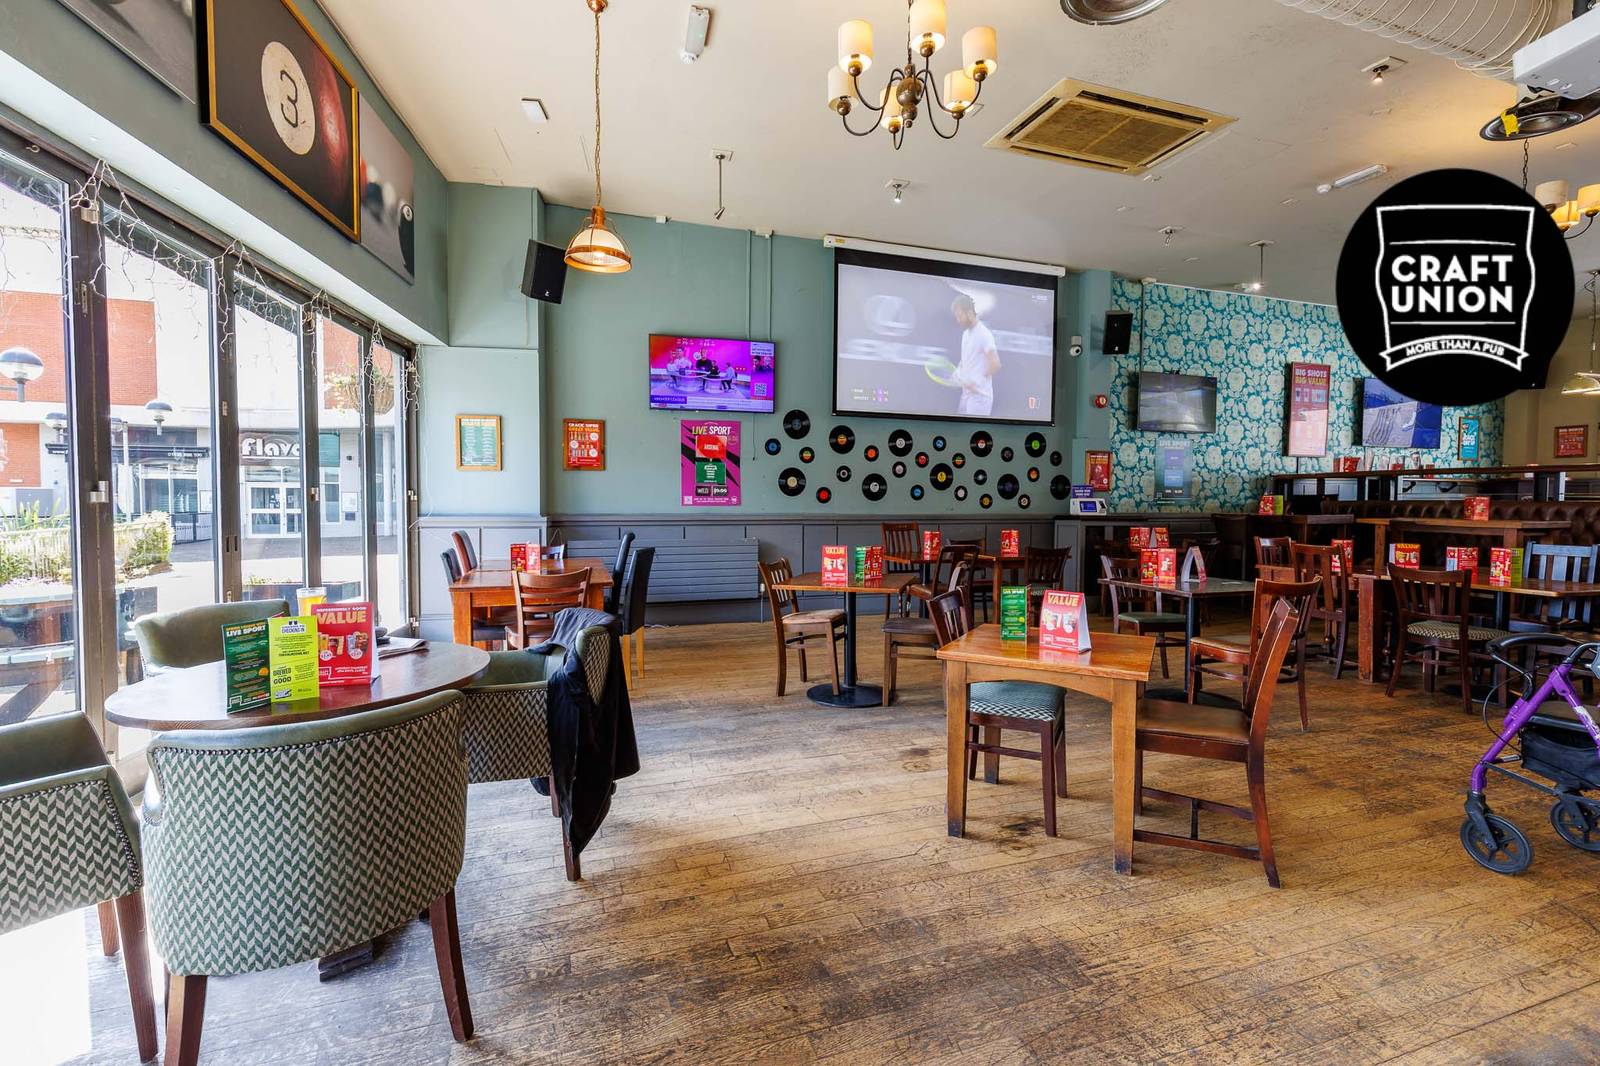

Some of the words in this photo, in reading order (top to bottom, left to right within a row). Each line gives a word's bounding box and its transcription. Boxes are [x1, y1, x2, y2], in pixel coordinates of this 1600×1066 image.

[280, 69, 299, 129] 3
[1295, 368, 1307, 376] BIG
[1307, 369, 1328, 378] SHOTS
[692, 425, 708, 435] LIVE
[709, 425, 731, 435] SPORT
[1047, 595, 1079, 607] VALUE
[317, 610, 367, 624] VALUE
[226, 629, 242, 637] LIVE
[243, 625, 265, 634] SPORT
[273, 676, 292, 685] GOOD
